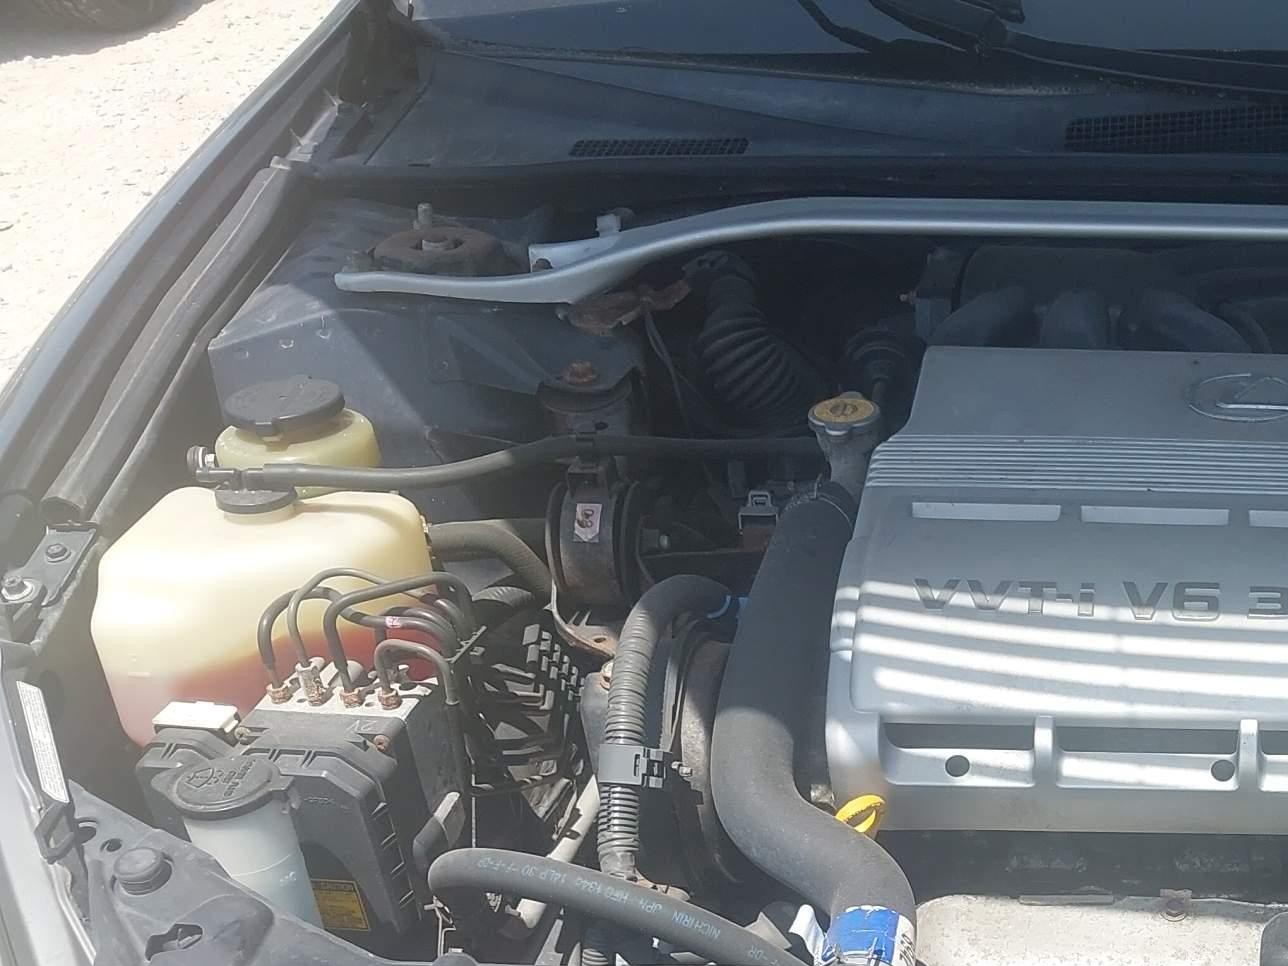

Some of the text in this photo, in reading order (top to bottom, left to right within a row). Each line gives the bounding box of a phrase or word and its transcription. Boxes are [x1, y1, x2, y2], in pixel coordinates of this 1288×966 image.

[913, 577, 1096, 617] VVT-i
[1122, 580, 1223, 622] V6
[672, 909, 721, 940] NICHIRIN
